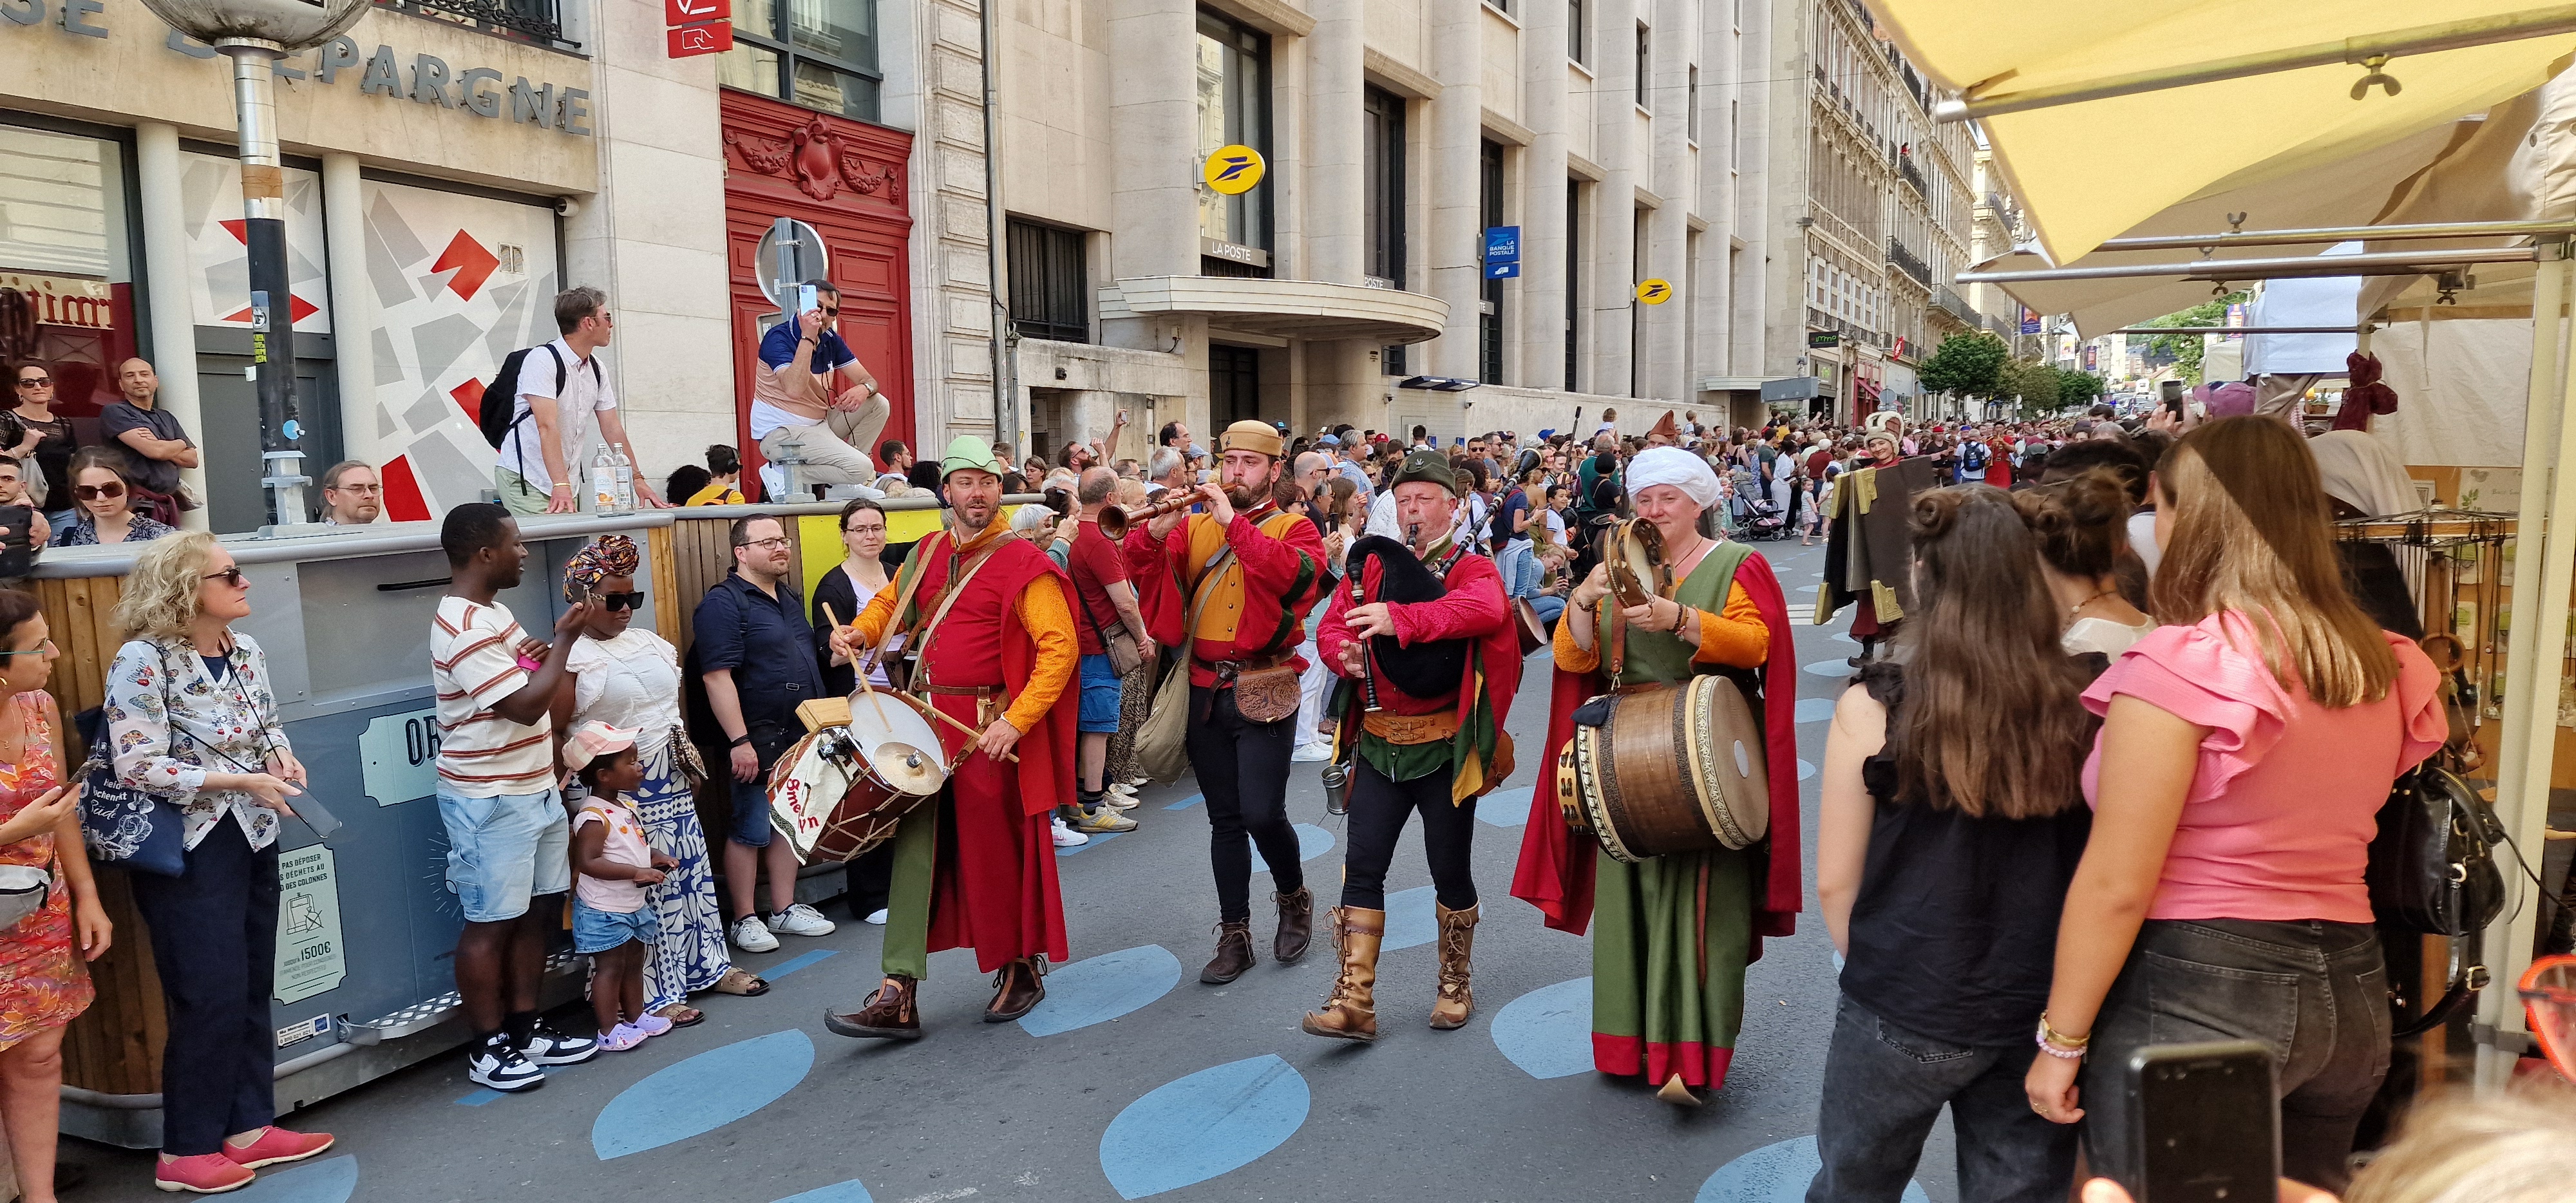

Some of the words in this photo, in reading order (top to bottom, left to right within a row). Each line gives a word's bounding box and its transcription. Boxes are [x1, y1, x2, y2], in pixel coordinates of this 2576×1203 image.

[1212, 241, 1224, 256] LA
[1224, 244, 1251, 261] POSTE
[1364, 276, 1384, 289] POSTE
[281, 860, 294, 870] PAS
[294, 853, 321, 866] DÉPOSER
[285, 866, 315, 880] DÉCHETS
[316, 863, 325, 871] AU
[285, 881, 296, 890] DES
[298, 873, 328, 887] COLONNES
[301, 941, 331, 961] 1500€
